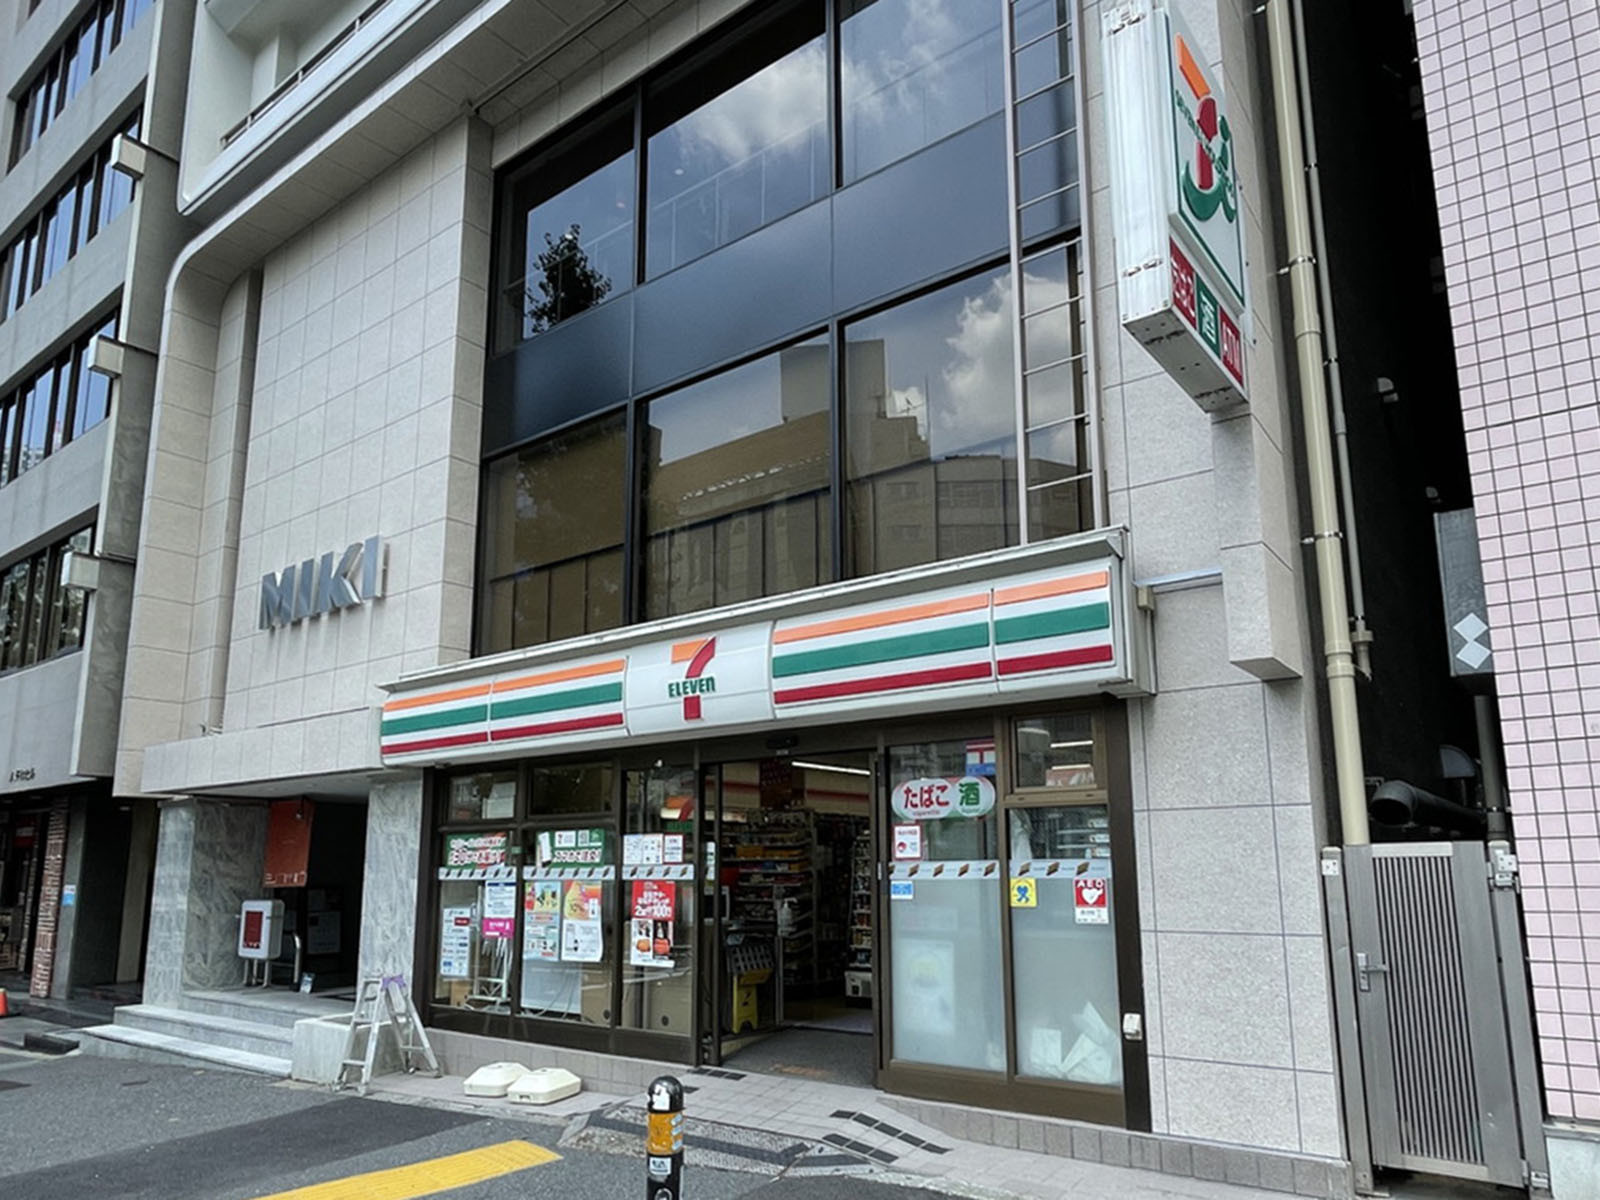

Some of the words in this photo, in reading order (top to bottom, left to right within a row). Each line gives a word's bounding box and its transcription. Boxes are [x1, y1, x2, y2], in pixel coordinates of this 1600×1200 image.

[259, 534, 385, 630] MIKI
[903, 784, 950, 809] たばこ
[959, 782, 981, 807] 酒
